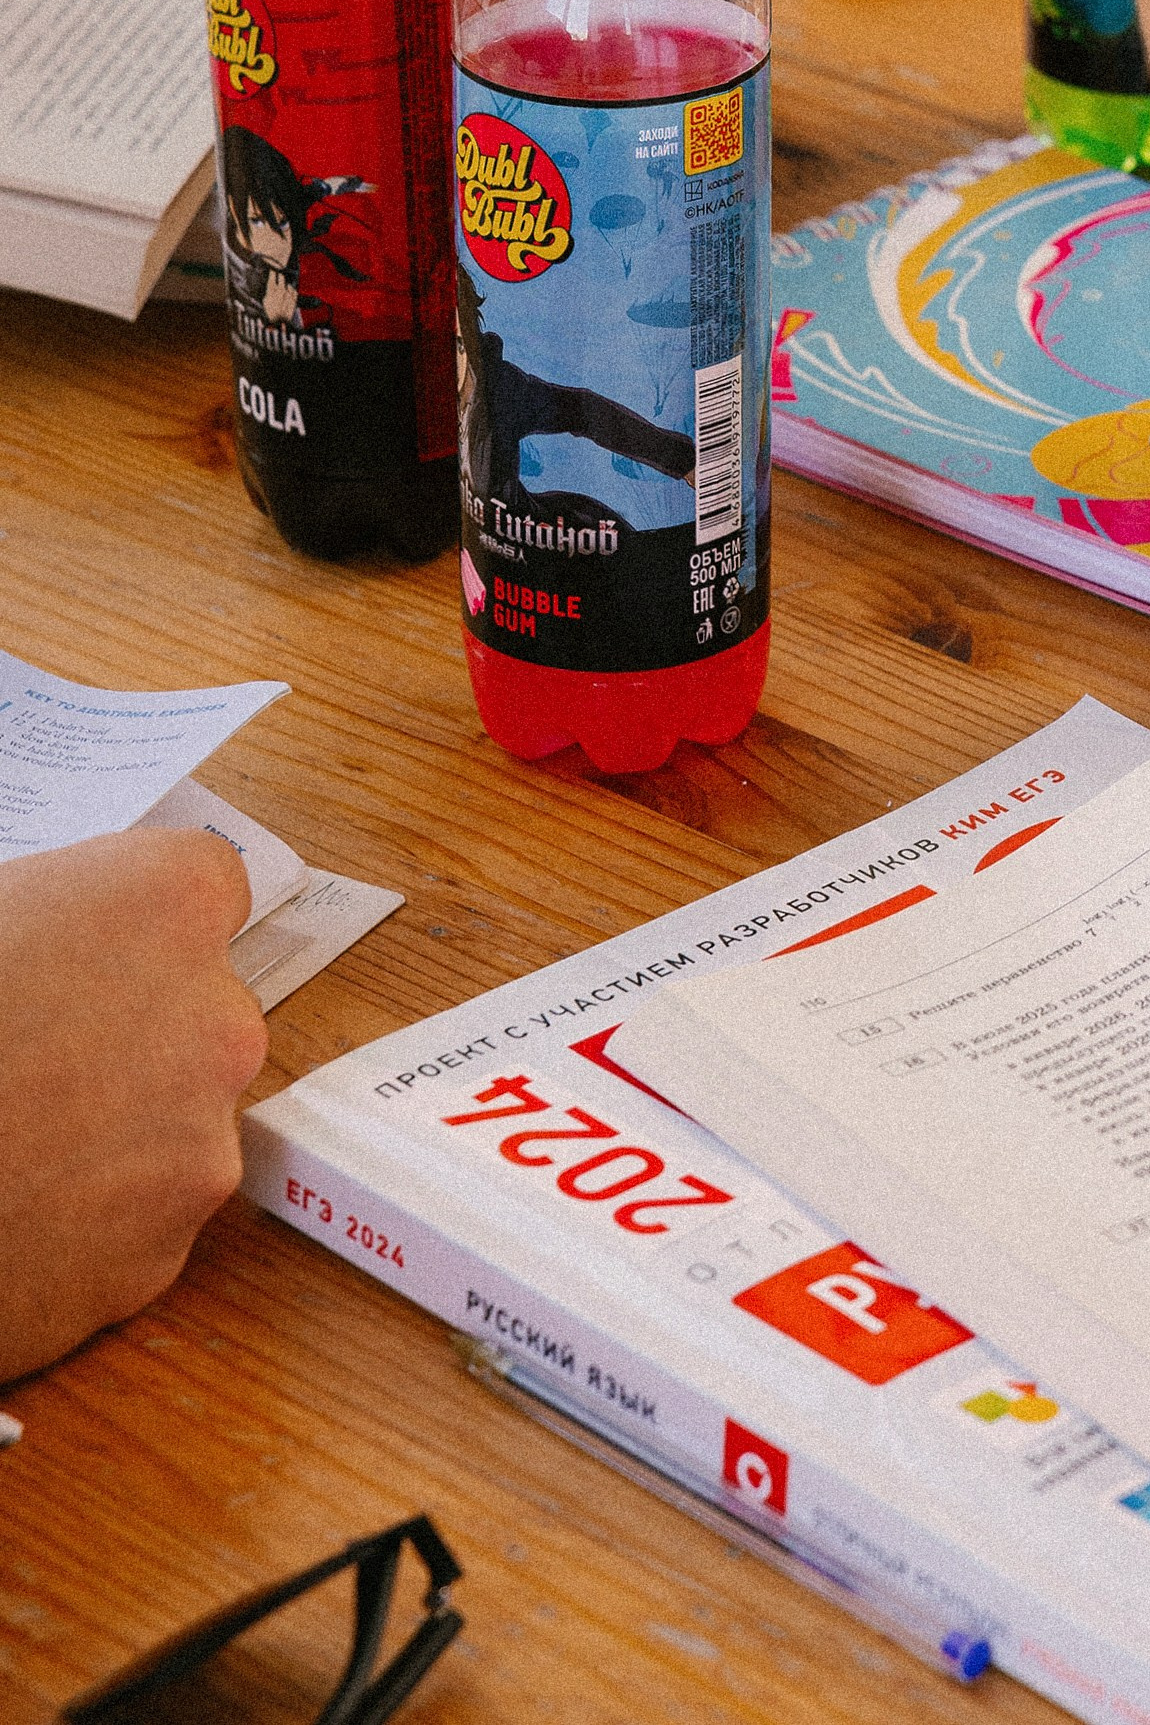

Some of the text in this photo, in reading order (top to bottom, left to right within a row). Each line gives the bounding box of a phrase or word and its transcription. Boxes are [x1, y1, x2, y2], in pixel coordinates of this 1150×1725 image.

[635, 146, 650, 160] НА
[638, 125, 679, 142] ЗАХОДИ
[456, 126, 534, 190] Dubl
[463, 180, 569, 270] Bubl
[238, 376, 307, 437] COLA
[690, 537, 742, 571] ОБЪЕМ
[690, 553, 742, 587] 500 МЛ
[493, 576, 583, 620] BUBBLE
[493, 603, 537, 639] GUM
[25, 688, 53, 704] KEY
[57, 699, 76, 712] TO
[374, 769, 1066, 1099] ПРОЕКТ С УЧАСТИЕМ РАЗРАБОТЧИКОВ КИМ ЕГЭ
[440, 1073, 736, 1235] 2024
[284, 1177, 661, 1426] ЕГЭ 2024 РУССКИЙ ЯЗЫК
